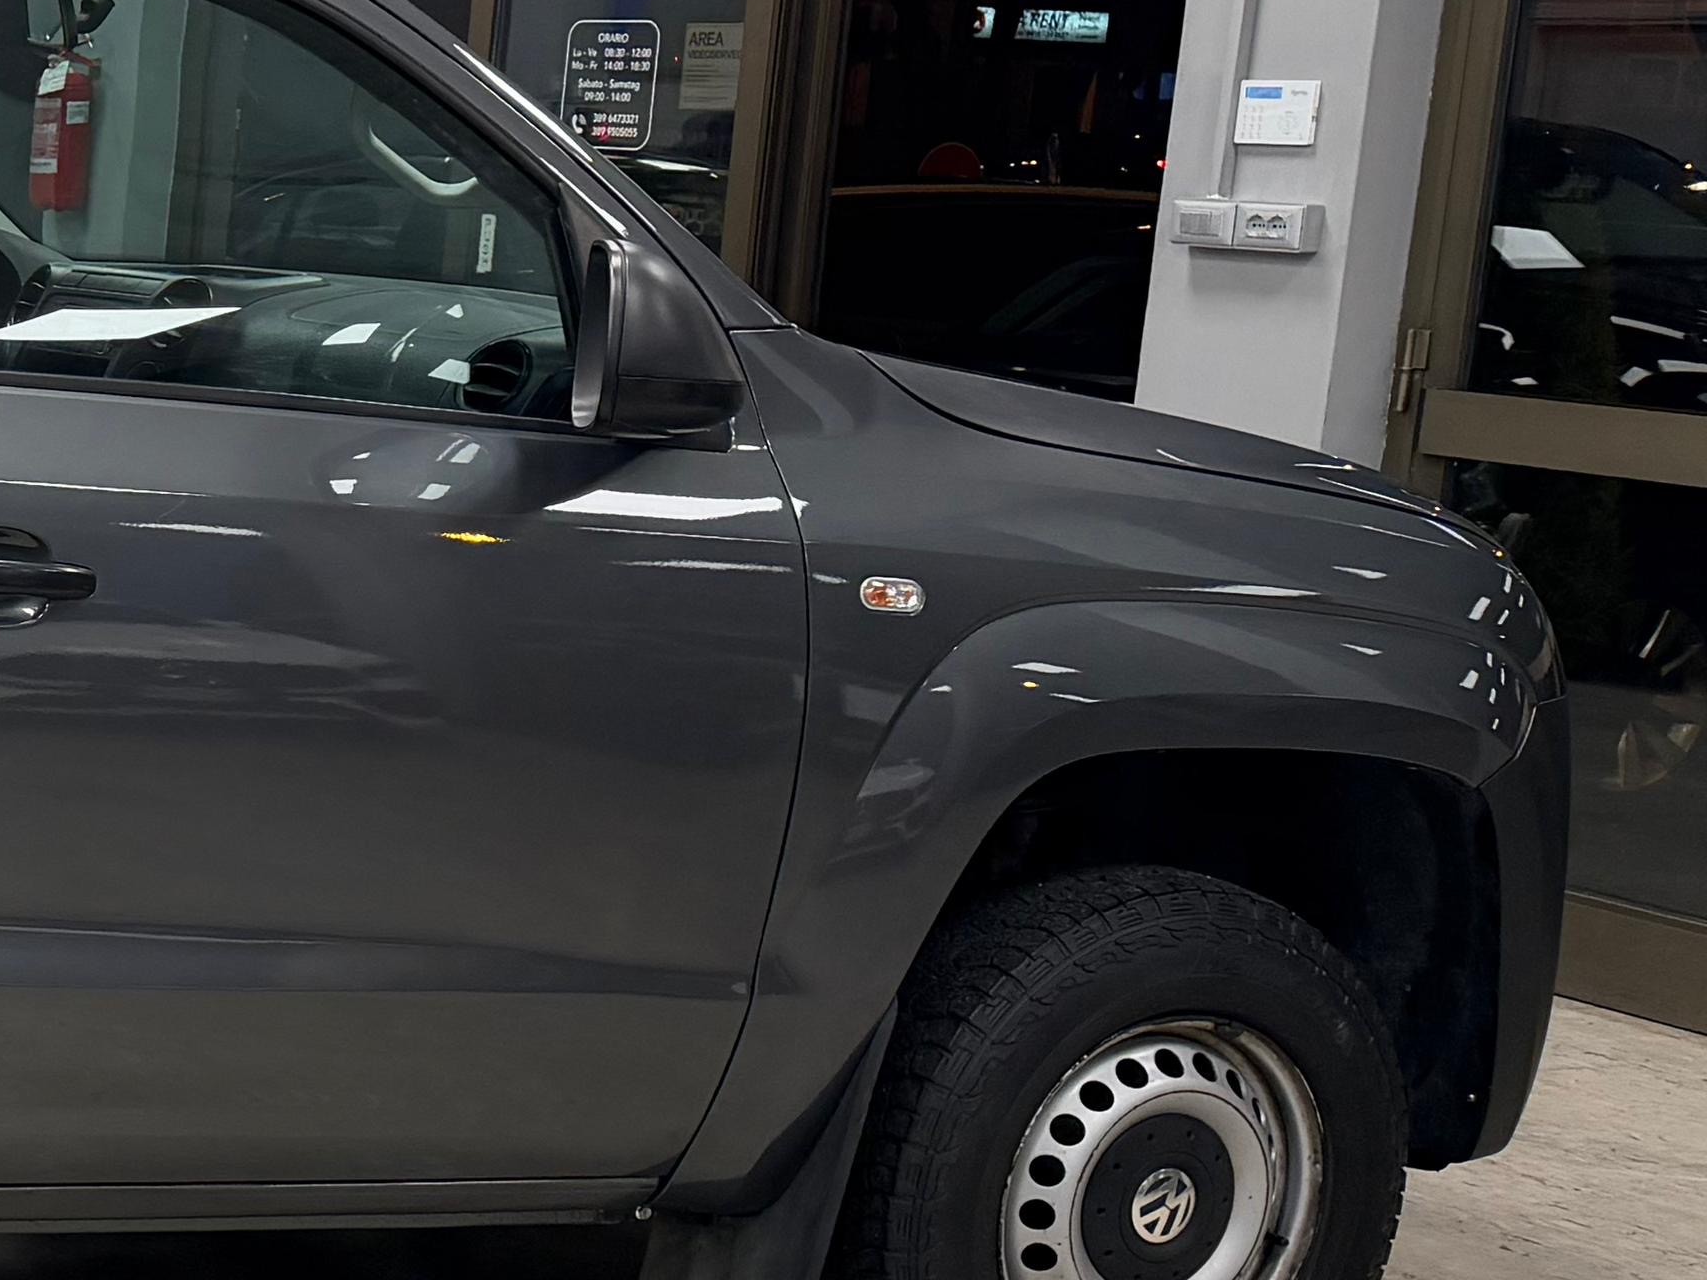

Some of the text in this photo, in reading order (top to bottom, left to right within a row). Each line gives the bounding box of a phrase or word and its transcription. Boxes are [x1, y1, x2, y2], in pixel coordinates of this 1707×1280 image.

[598, 33, 629, 43] ORARIO
[689, 32, 724, 46] AREA
[631, 48, 652, 58] 12:00
[604, 61, 624, 71] 14:00
[578, 78, 603, 89] Sabato
[609, 78, 641, 92] Samstag
[584, 92, 605, 101] 09:00
[610, 92, 632, 102] 14:00
